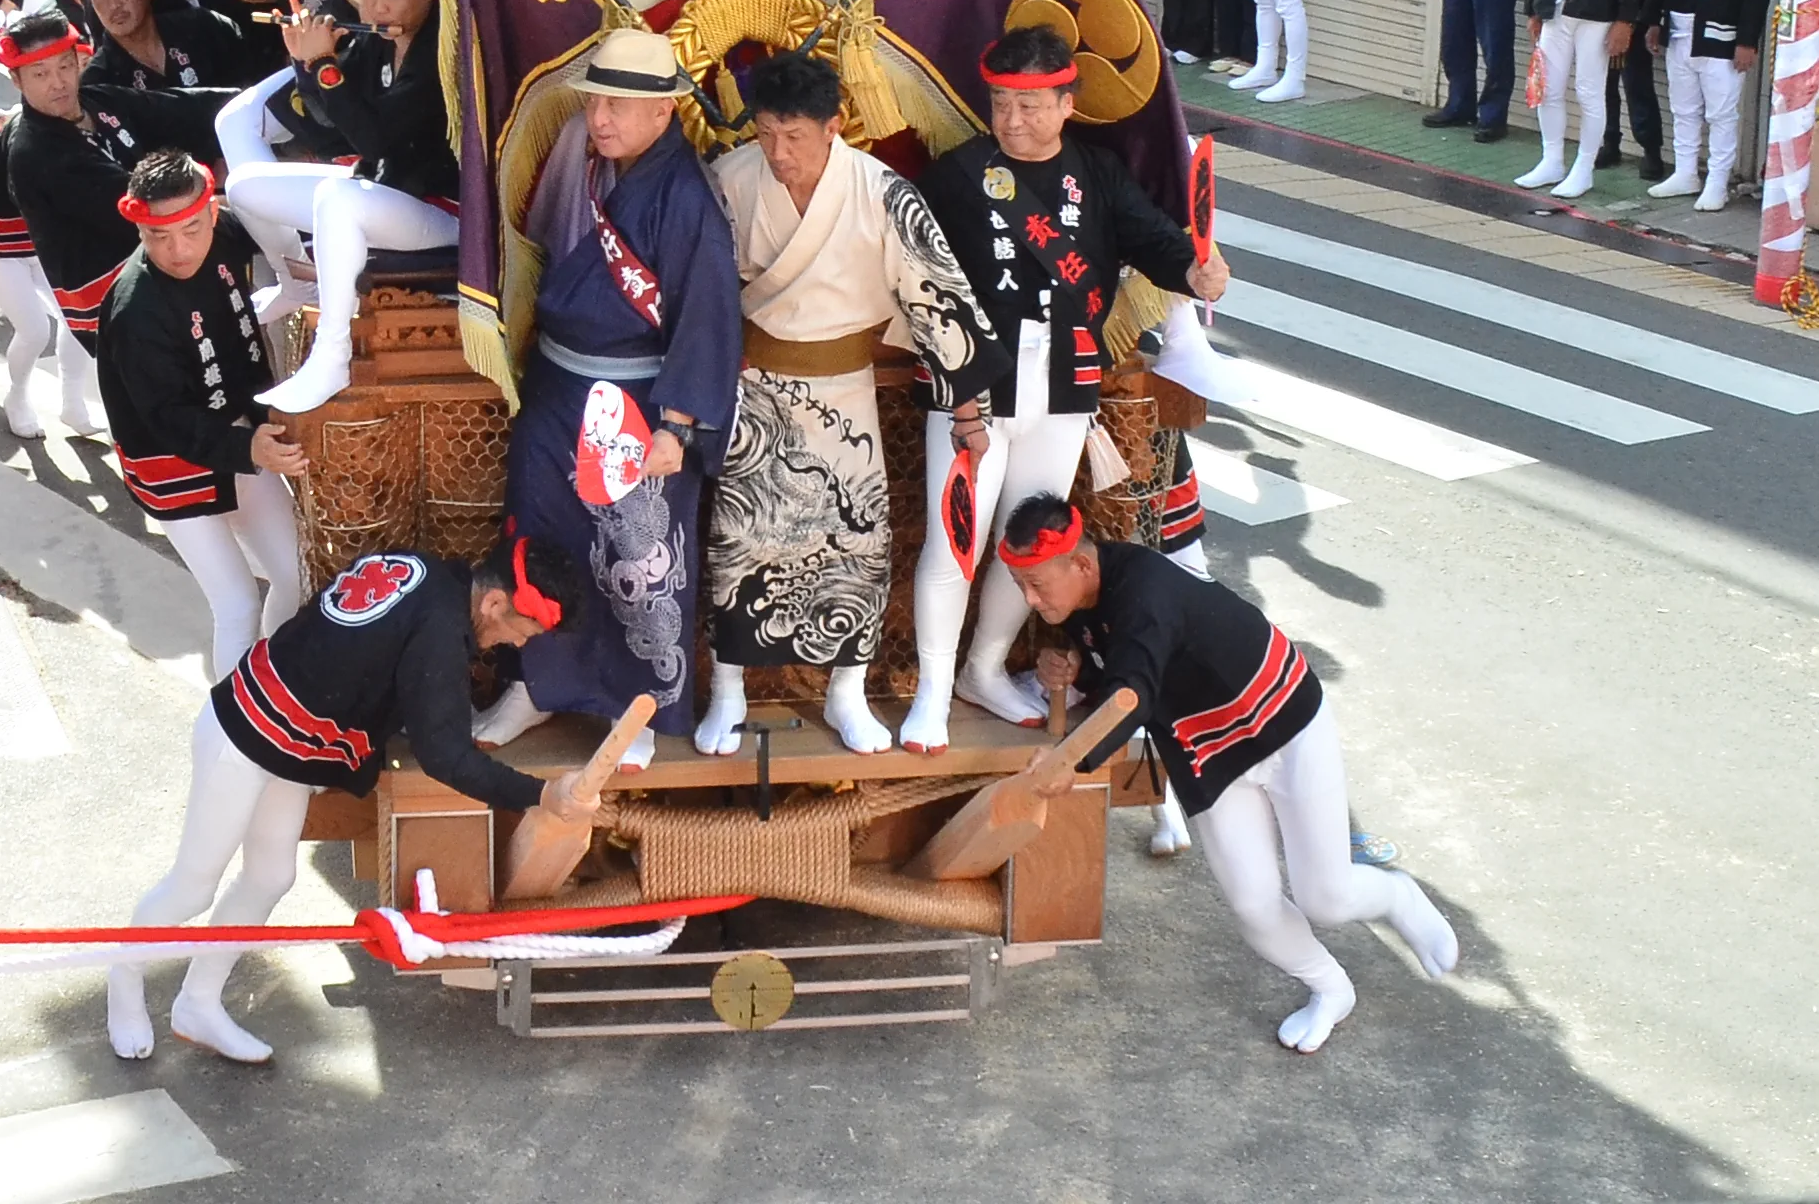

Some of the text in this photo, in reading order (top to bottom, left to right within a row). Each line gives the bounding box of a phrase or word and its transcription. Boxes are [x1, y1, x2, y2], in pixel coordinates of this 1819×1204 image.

[1062, 174, 1083, 204] 大町
[1025, 213, 1103, 321] 責任者
